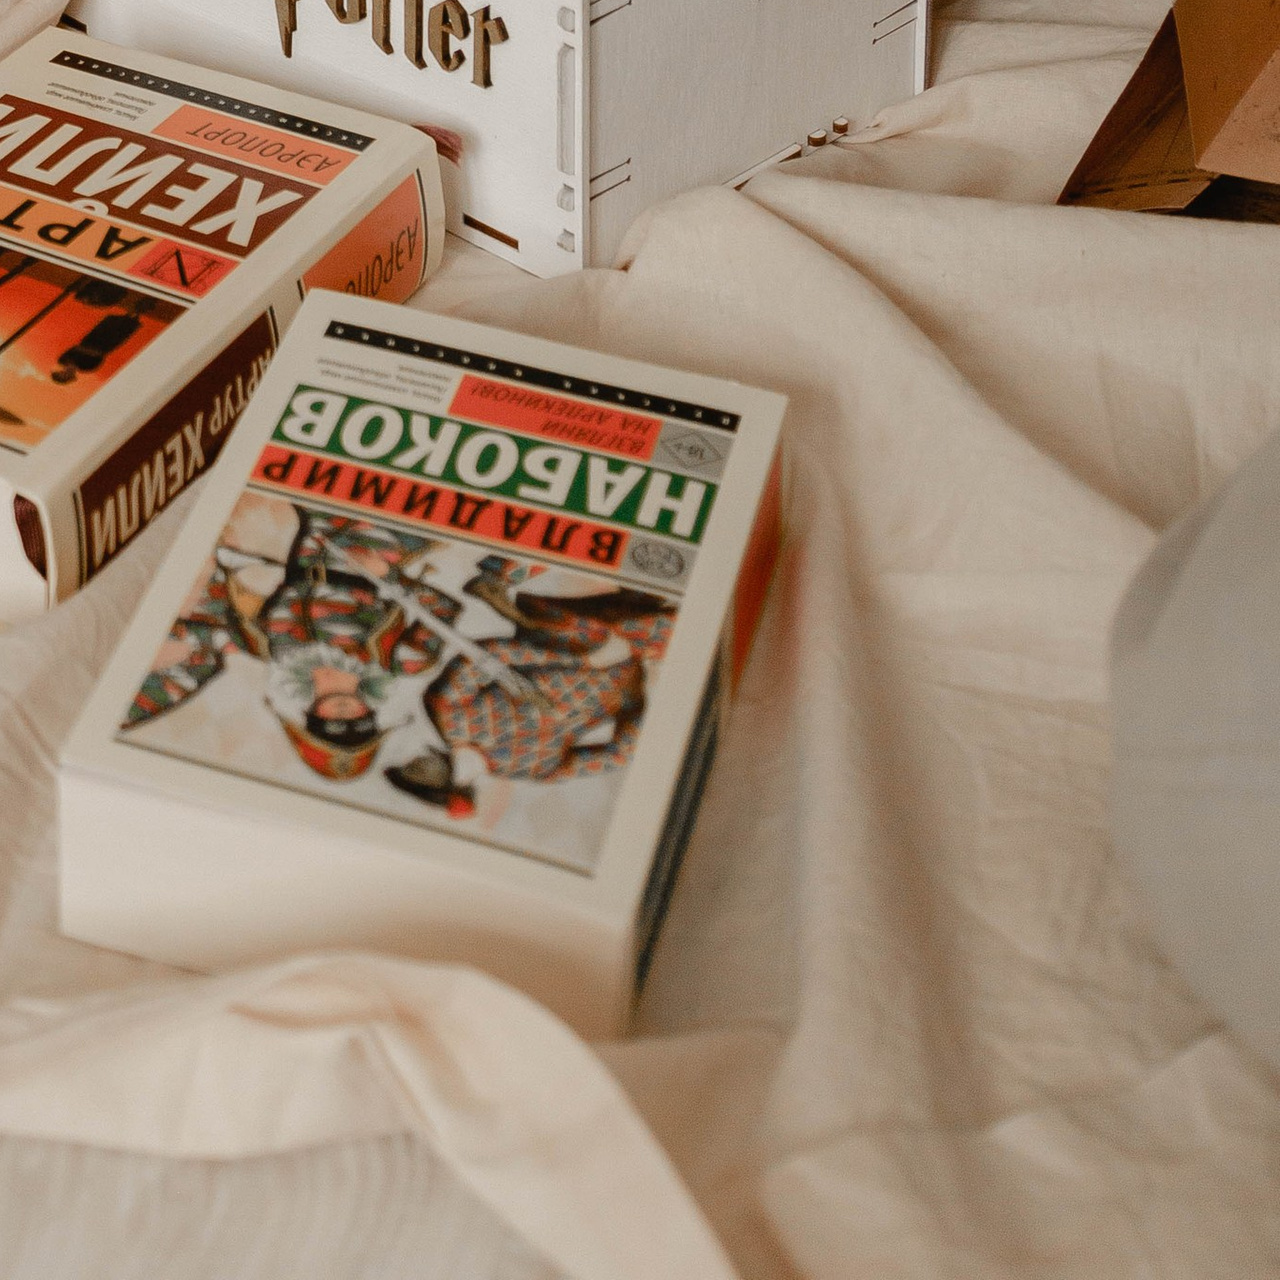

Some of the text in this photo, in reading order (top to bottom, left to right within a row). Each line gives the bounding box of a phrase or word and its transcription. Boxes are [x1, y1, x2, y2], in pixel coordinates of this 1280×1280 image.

[184, 118, 343, 176] АЭРОПОРТ
[270, 383, 710, 540] НАБОКОВ
[617, 415, 654, 437] НА
[255, 446, 627, 567] ВЛАДИМИР
